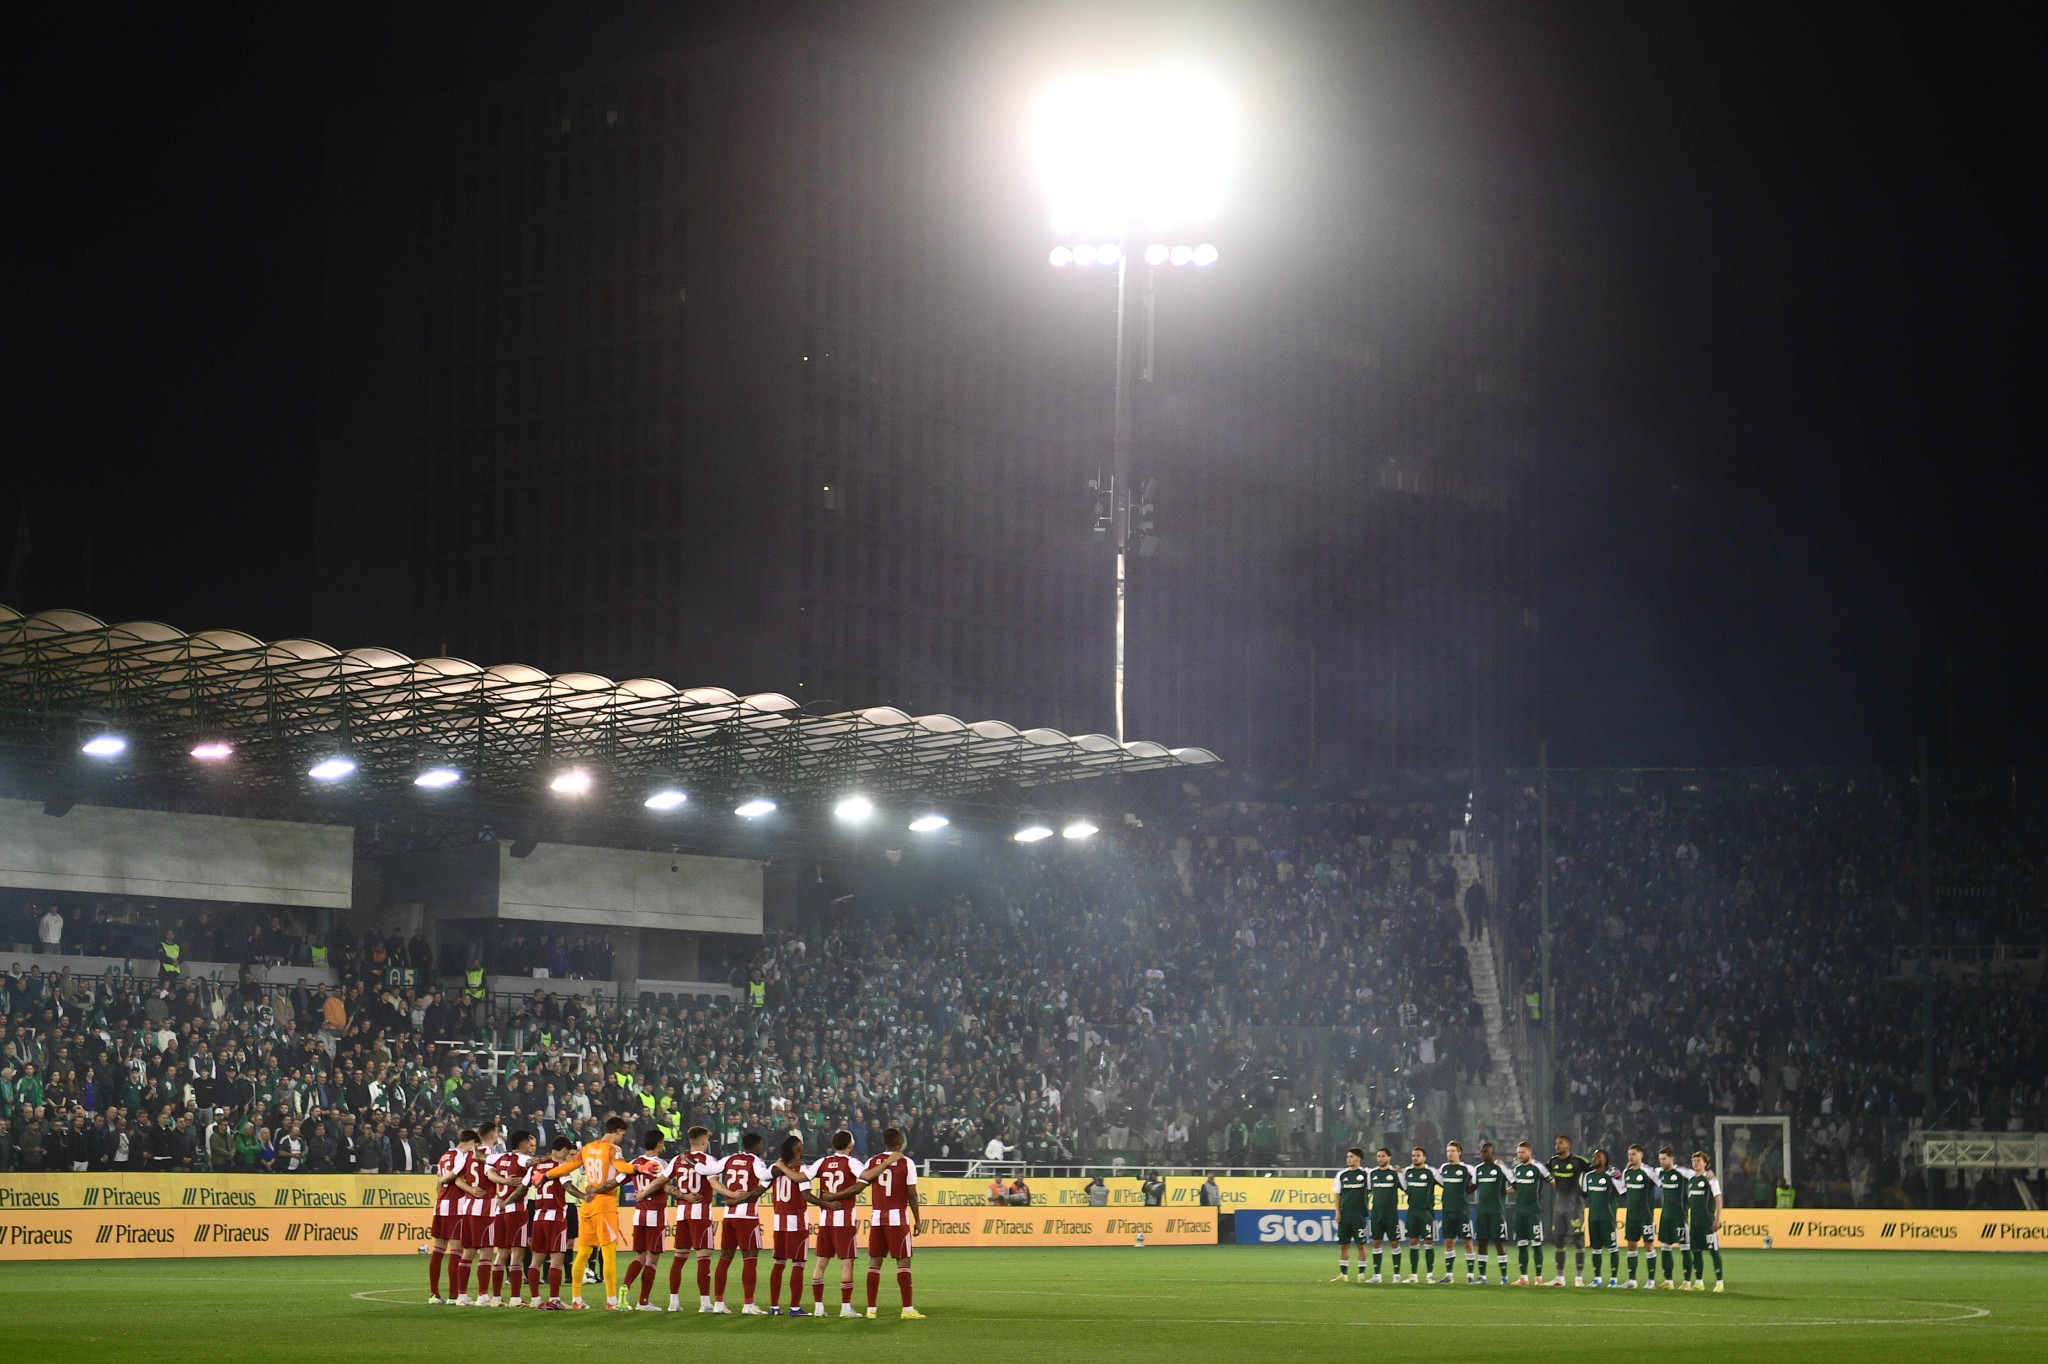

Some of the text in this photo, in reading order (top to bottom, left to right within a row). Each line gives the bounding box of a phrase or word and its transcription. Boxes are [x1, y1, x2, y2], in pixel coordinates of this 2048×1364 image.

[470, 1162, 480, 1188] 5
[586, 1157, 603, 1184] 88
[677, 1167, 701, 1194] 20
[726, 1168, 749, 1192] 23
[775, 1175, 792, 1203] 10
[822, 1170, 845, 1193] 32
[878, 1168, 893, 1196] 9
[0, 1188, 60, 1206] Piraeus
[103, 1187, 160, 1206] Piraeus
[201, 1187, 256, 1206] Piraeus
[292, 1188, 347, 1206] Piraeus
[378, 1188, 430, 1206] Piraeus
[949, 1190, 986, 1205] Piraeus
[1289, 1189, 1335, 1203] Piraeu
[11, 1226, 72, 1244] Piraeus
[116, 1224, 175, 1243] Piraeus
[213, 1223, 269, 1242] Piraeus
[303, 1223, 358, 1241] Piraeus
[397, 1222, 432, 1240] Pirae
[931, 1219, 970, 1234] Piraeus
[995, 1219, 1033, 1234] Piraeus
[1056, 1219, 1092, 1234] Piraeus
[1118, 1219, 1153, 1233] Piraeus
[1177, 1219, 1211, 1233] Piraeus
[1718, 1221, 1769, 1236] iraeus
[1808, 1221, 1865, 1237] Piraeus
[1900, 1222, 1957, 1238] Piraeus
[2000, 1223, 2048, 1239] Piraeu
